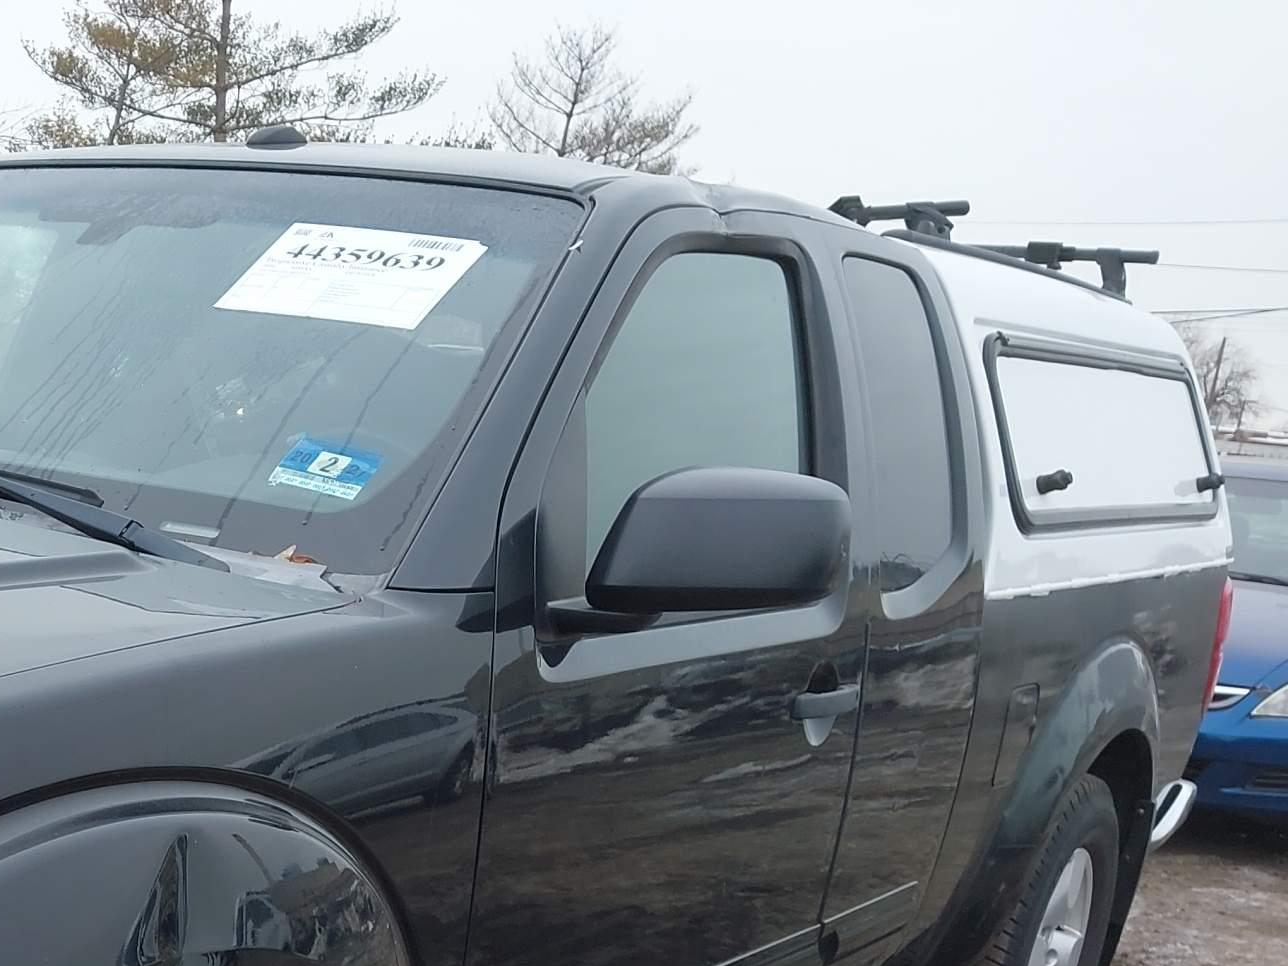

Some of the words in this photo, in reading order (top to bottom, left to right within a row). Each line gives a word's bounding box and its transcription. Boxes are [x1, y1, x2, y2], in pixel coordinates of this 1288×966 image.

[287, 243, 446, 271] 44359639
[291, 450, 312, 464] 20
[319, 456, 340, 473] 2
